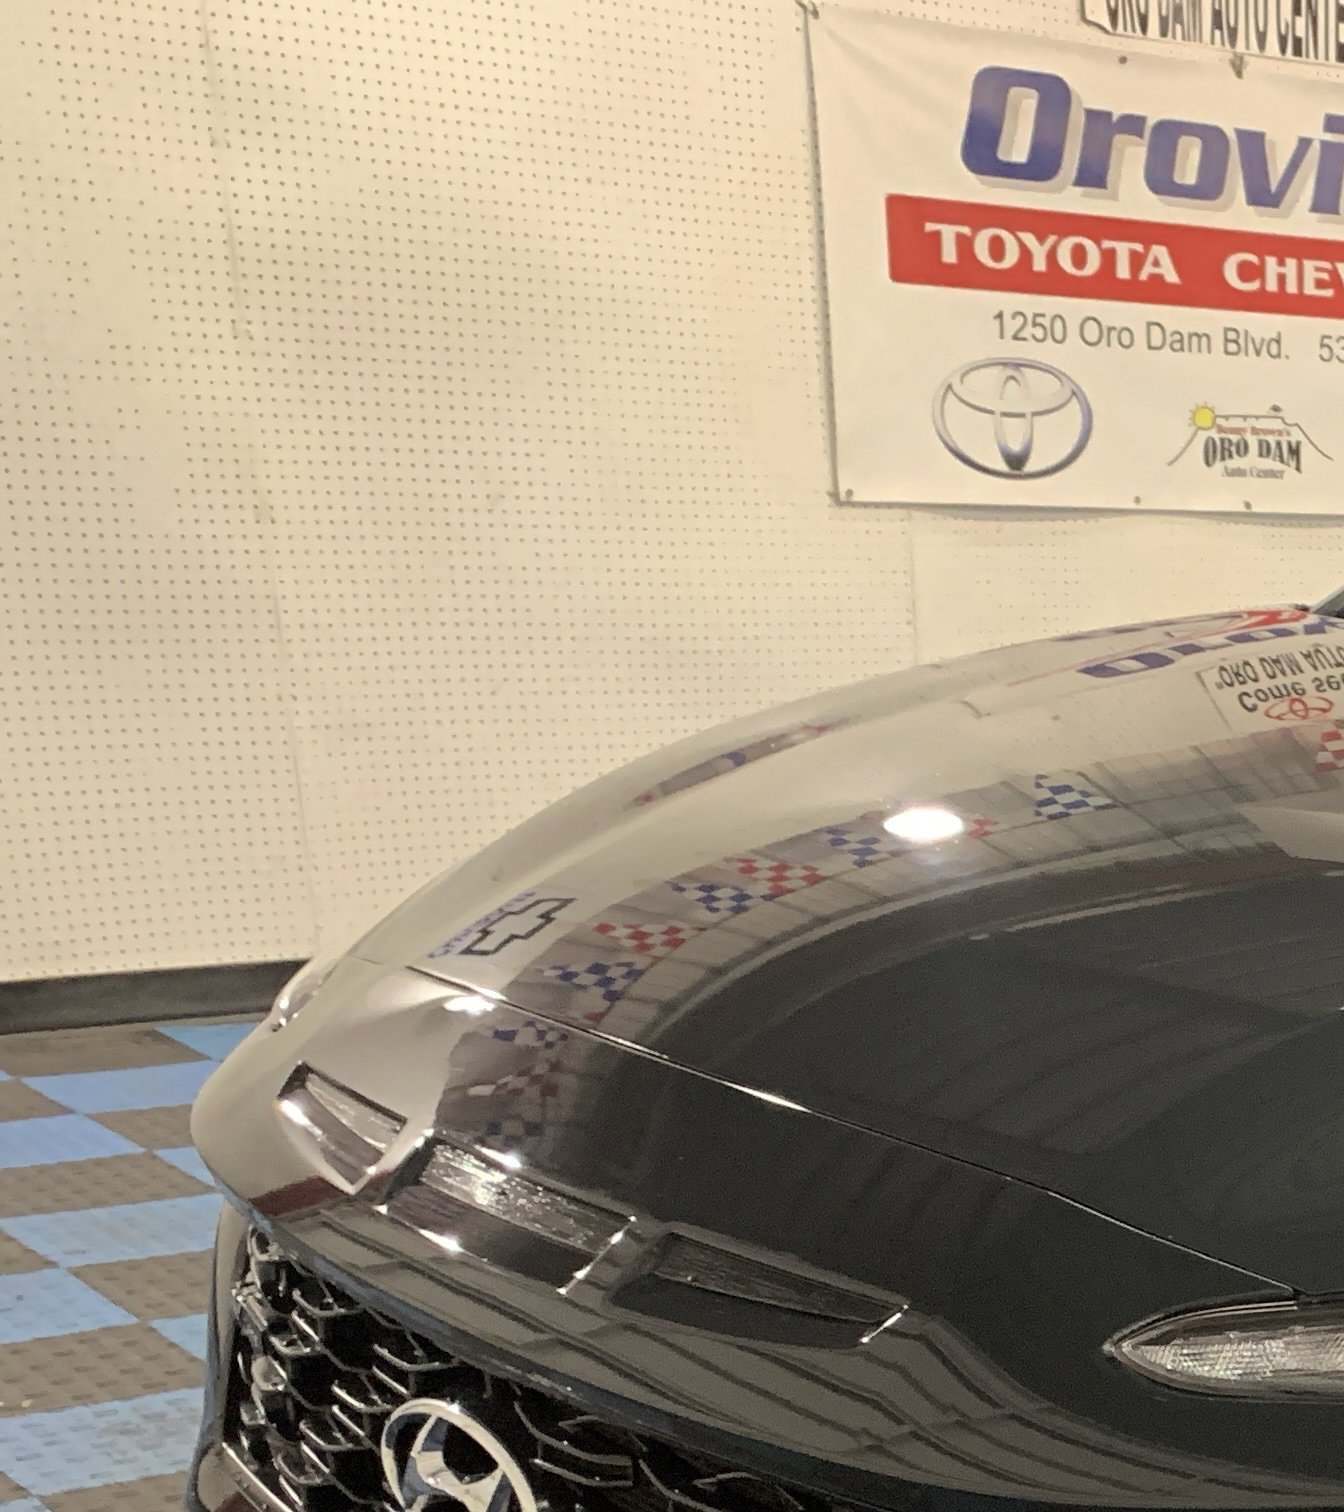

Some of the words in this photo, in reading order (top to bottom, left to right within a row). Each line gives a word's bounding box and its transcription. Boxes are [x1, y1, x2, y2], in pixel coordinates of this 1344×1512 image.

[924, 222, 1181, 284] TOYOTA
[993, 310, 1067, 344] 1250
[1079, 316, 1134, 349] Oro
[1146, 321, 1211, 354] Dam
[1223, 327, 1289, 359] Blvd.
[1203, 436, 1249, 468] ORO
[1257, 438, 1302, 474] DAM
